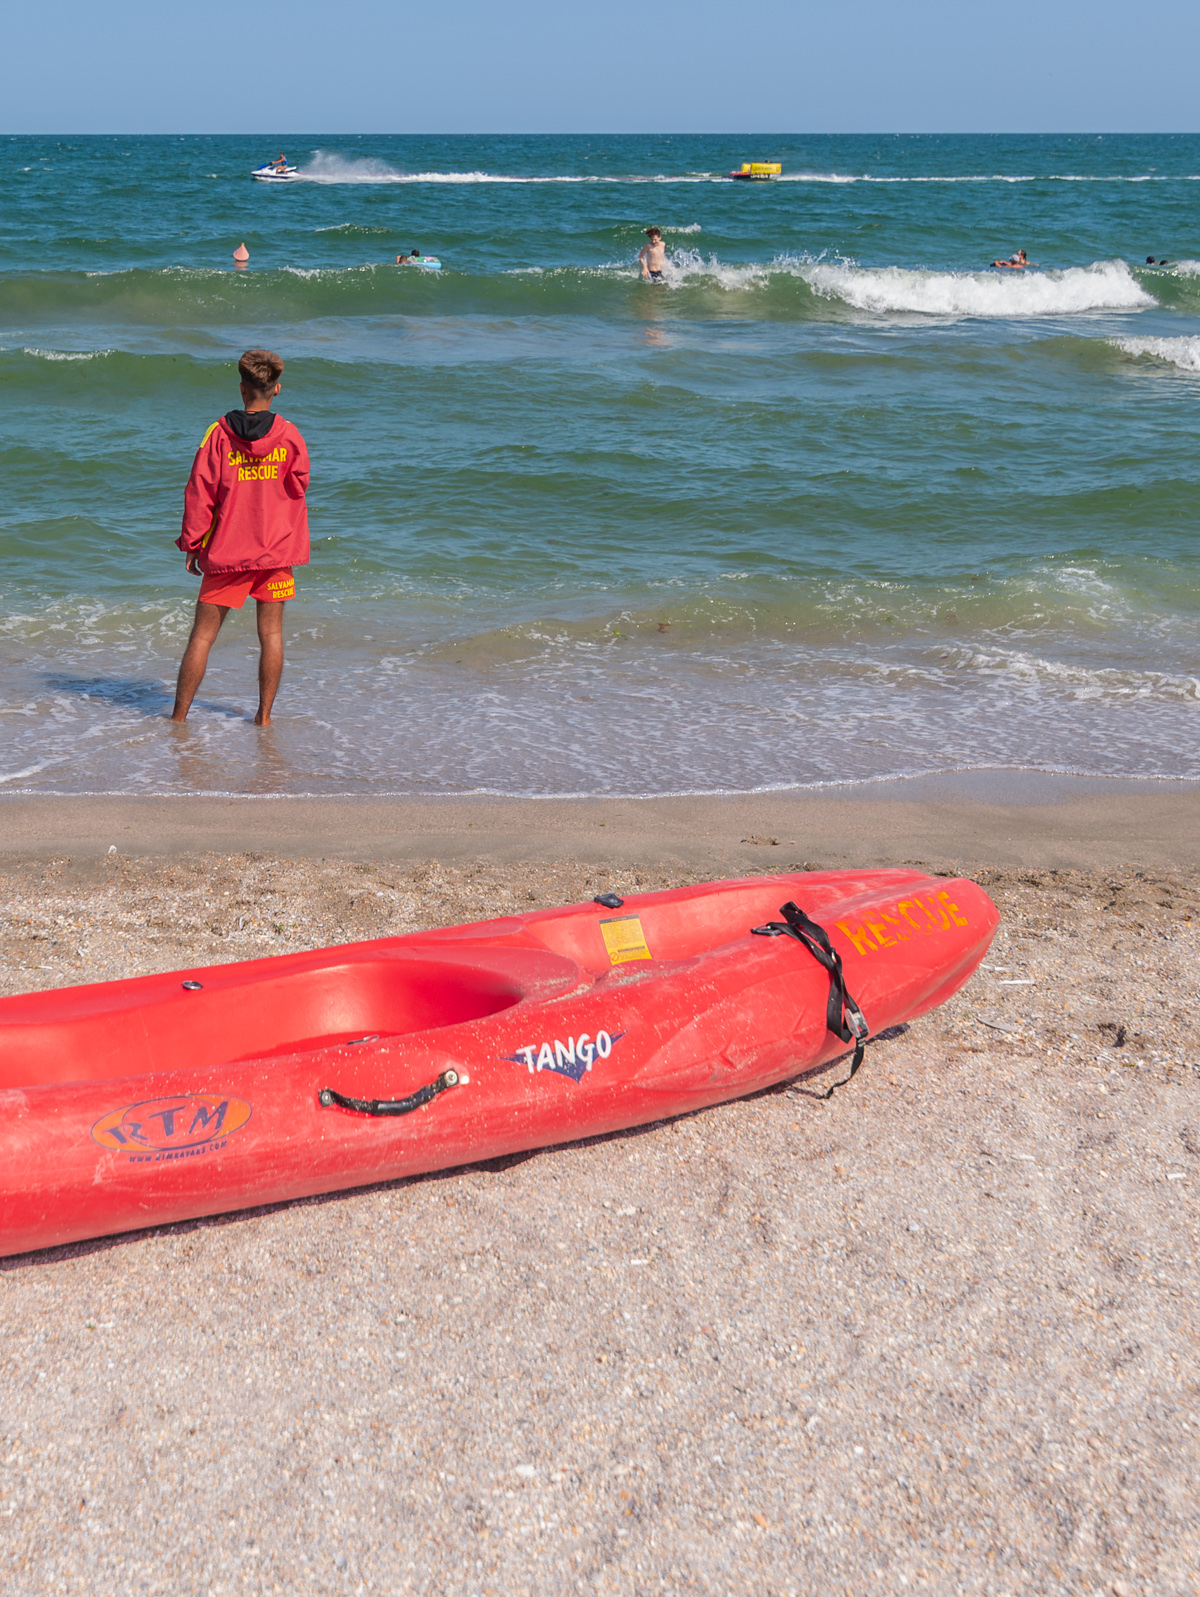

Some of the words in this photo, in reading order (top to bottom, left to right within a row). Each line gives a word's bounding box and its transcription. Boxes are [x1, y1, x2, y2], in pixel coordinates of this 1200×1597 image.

[238, 465, 278, 481] RESCUE
[272, 587, 294, 599] RESCUE
[834, 891, 968, 956] RESCUE
[516, 1030, 612, 1074] TANGO
[103, 1100, 229, 1144] RTM
